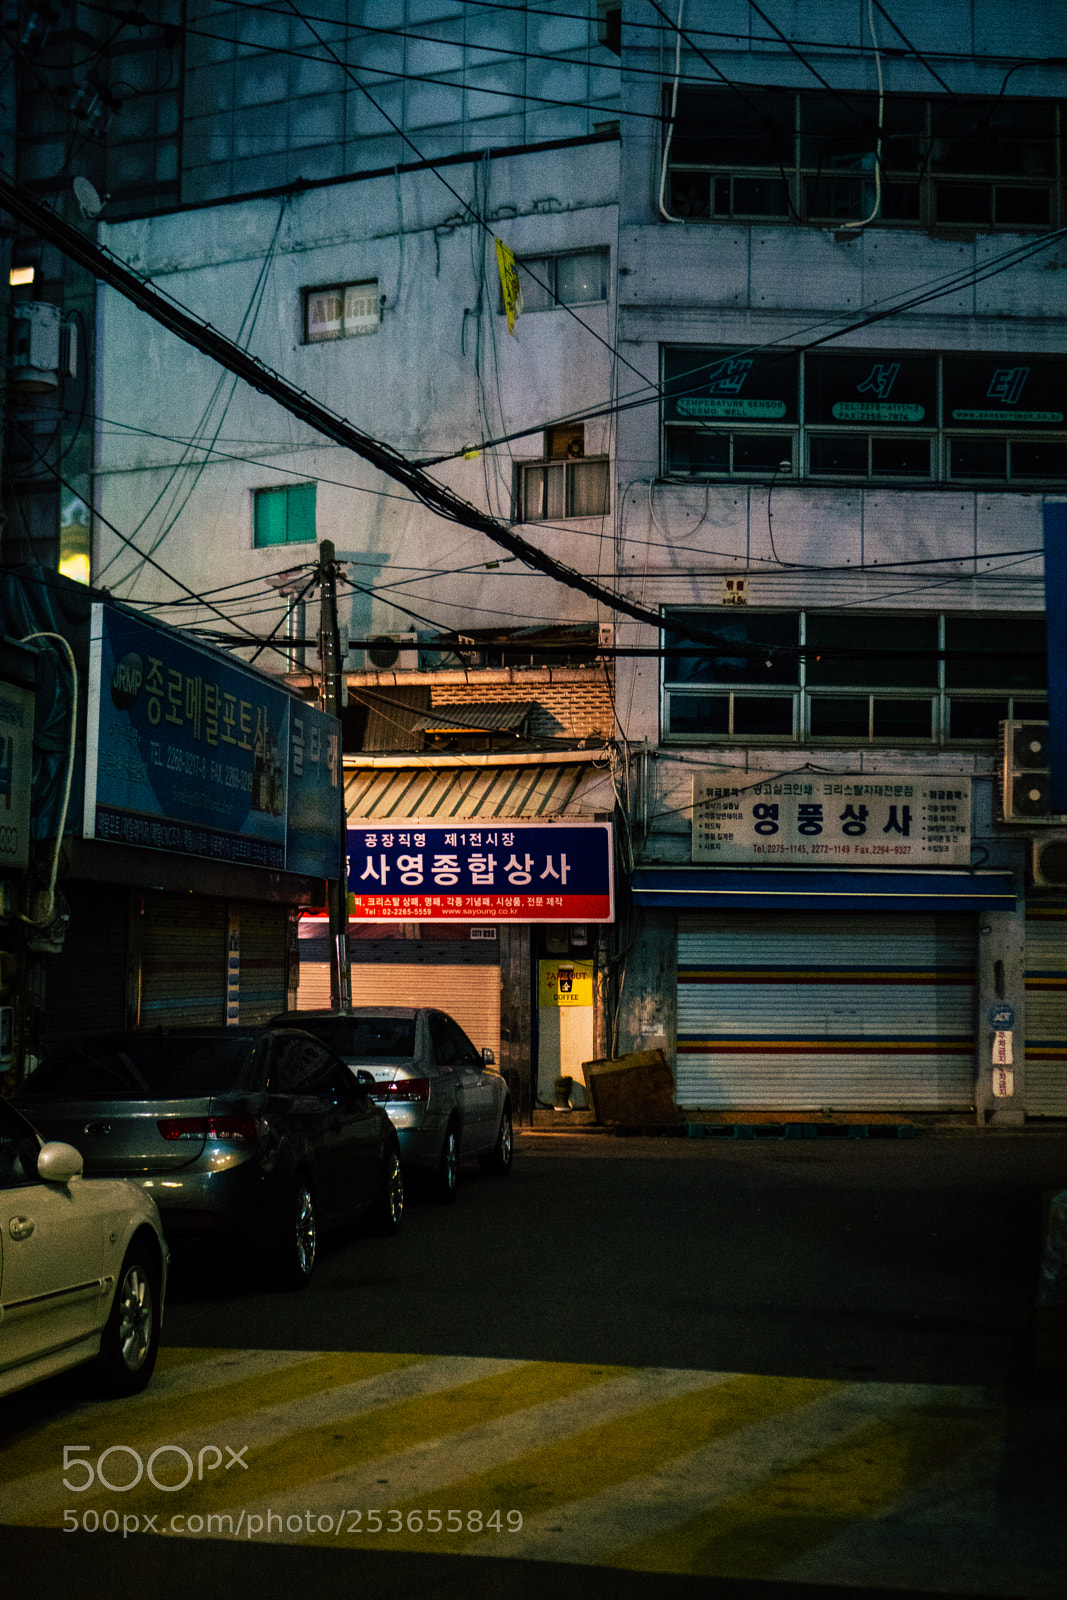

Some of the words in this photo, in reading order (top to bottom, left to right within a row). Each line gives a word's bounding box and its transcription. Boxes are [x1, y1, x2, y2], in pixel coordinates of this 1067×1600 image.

[857, 363, 901, 399] 서
[986, 366, 1031, 404] 테
[680, 398, 744, 408] TEMPERATURE
[748, 400, 783, 409] SENSOR
[752, 803, 913, 837] 영풍상사
[364, 832, 427, 848] 공장직영
[443, 832, 516, 848] 제1전시장
[752, 843, 809, 856] Tel.2275-1145,
[811, 844, 850, 855] 2272-1149
[366, 896, 401, 907] 크리스탈
[446, 896, 463, 908] 각종
[526, 896, 543, 908] 전문
[545, 896, 563, 907] 제작
[364, 907, 376, 916] Tel
[382, 907, 432, 916] 02-2265-5559
[441, 907, 518, 917] www.sayoung.co.kr
[568, 972, 588, 980] OUT
[993, 1012, 1012, 1022] ADT
